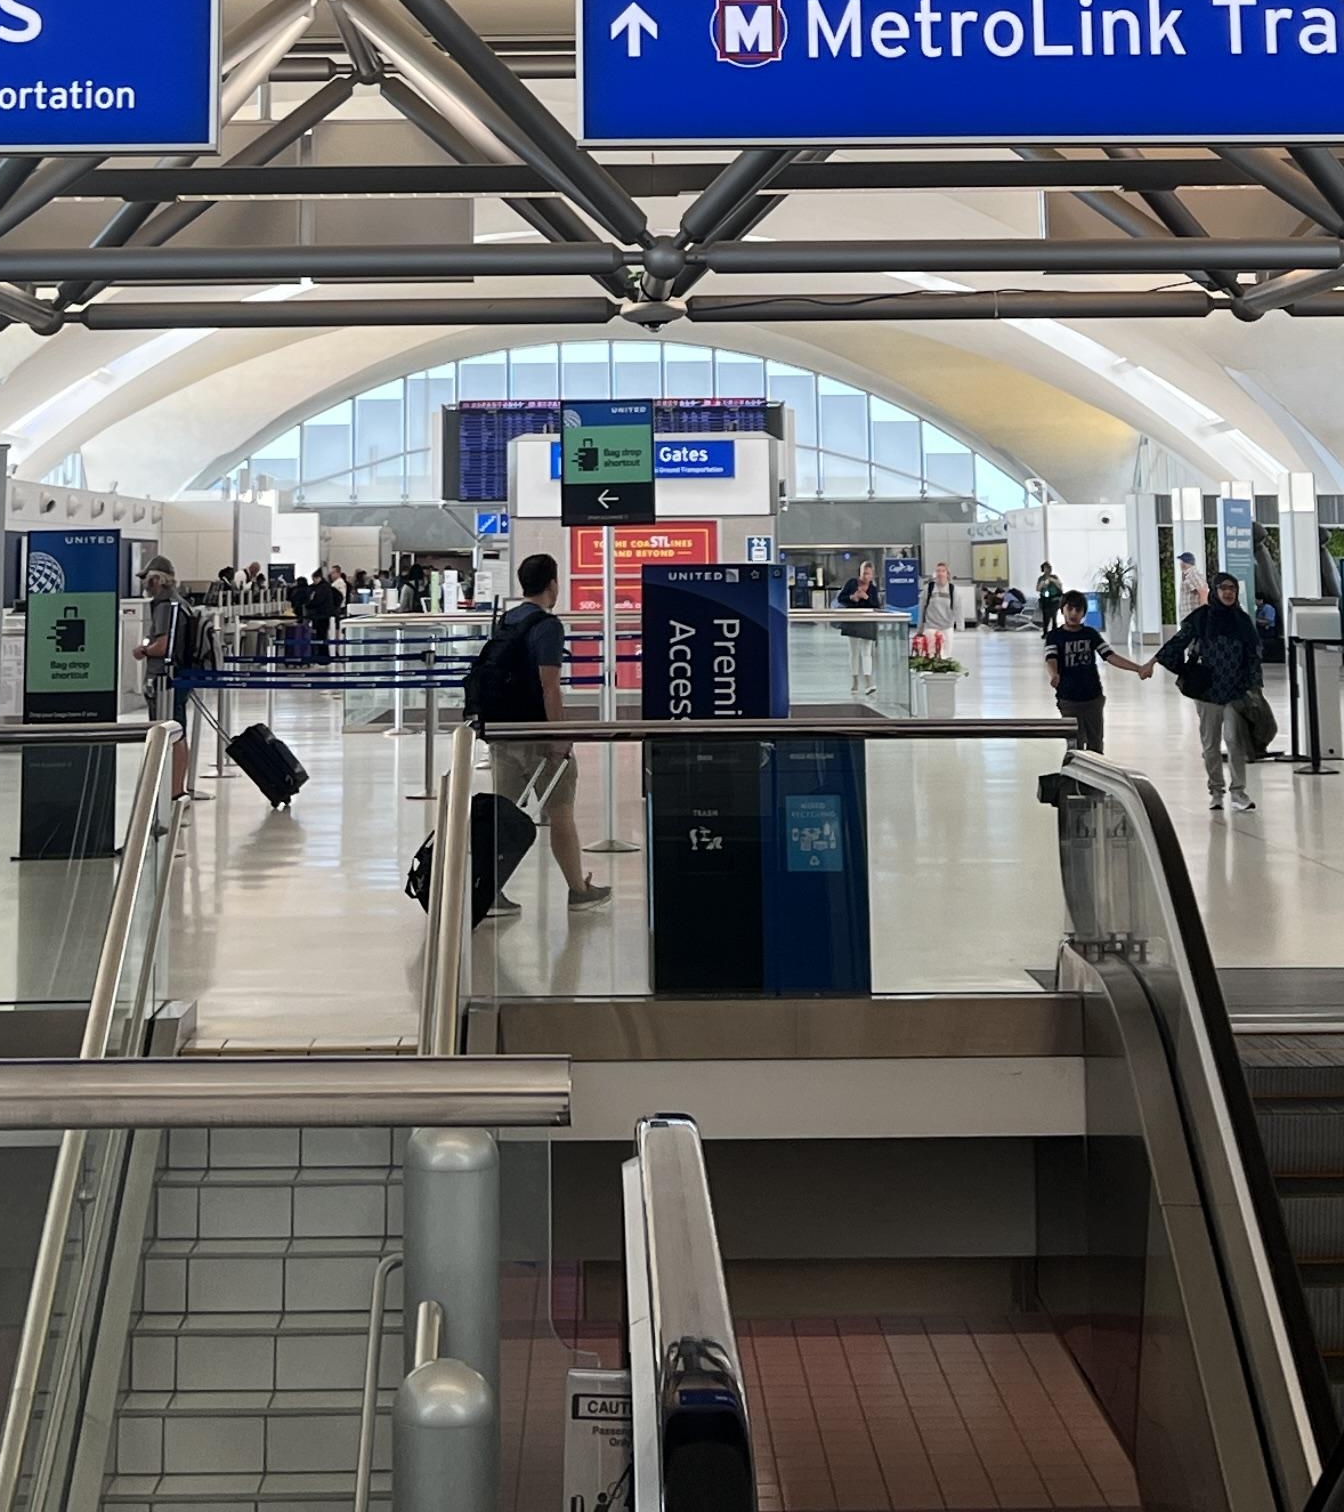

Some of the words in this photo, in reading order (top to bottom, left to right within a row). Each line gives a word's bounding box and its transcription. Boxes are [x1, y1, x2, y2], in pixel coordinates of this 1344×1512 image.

[725, 7, 773, 52] M
[611, 406, 646, 414] UNITED
[659, 446, 709, 463] Gates
[65, 536, 115, 544] UNITED
[668, 572, 723, 581] UNITED
[1065, 639, 1092, 654] KICK
[50, 660, 67, 671] Bag
[69, 660, 90, 671] drop
[713, 619, 743, 716] Premi
